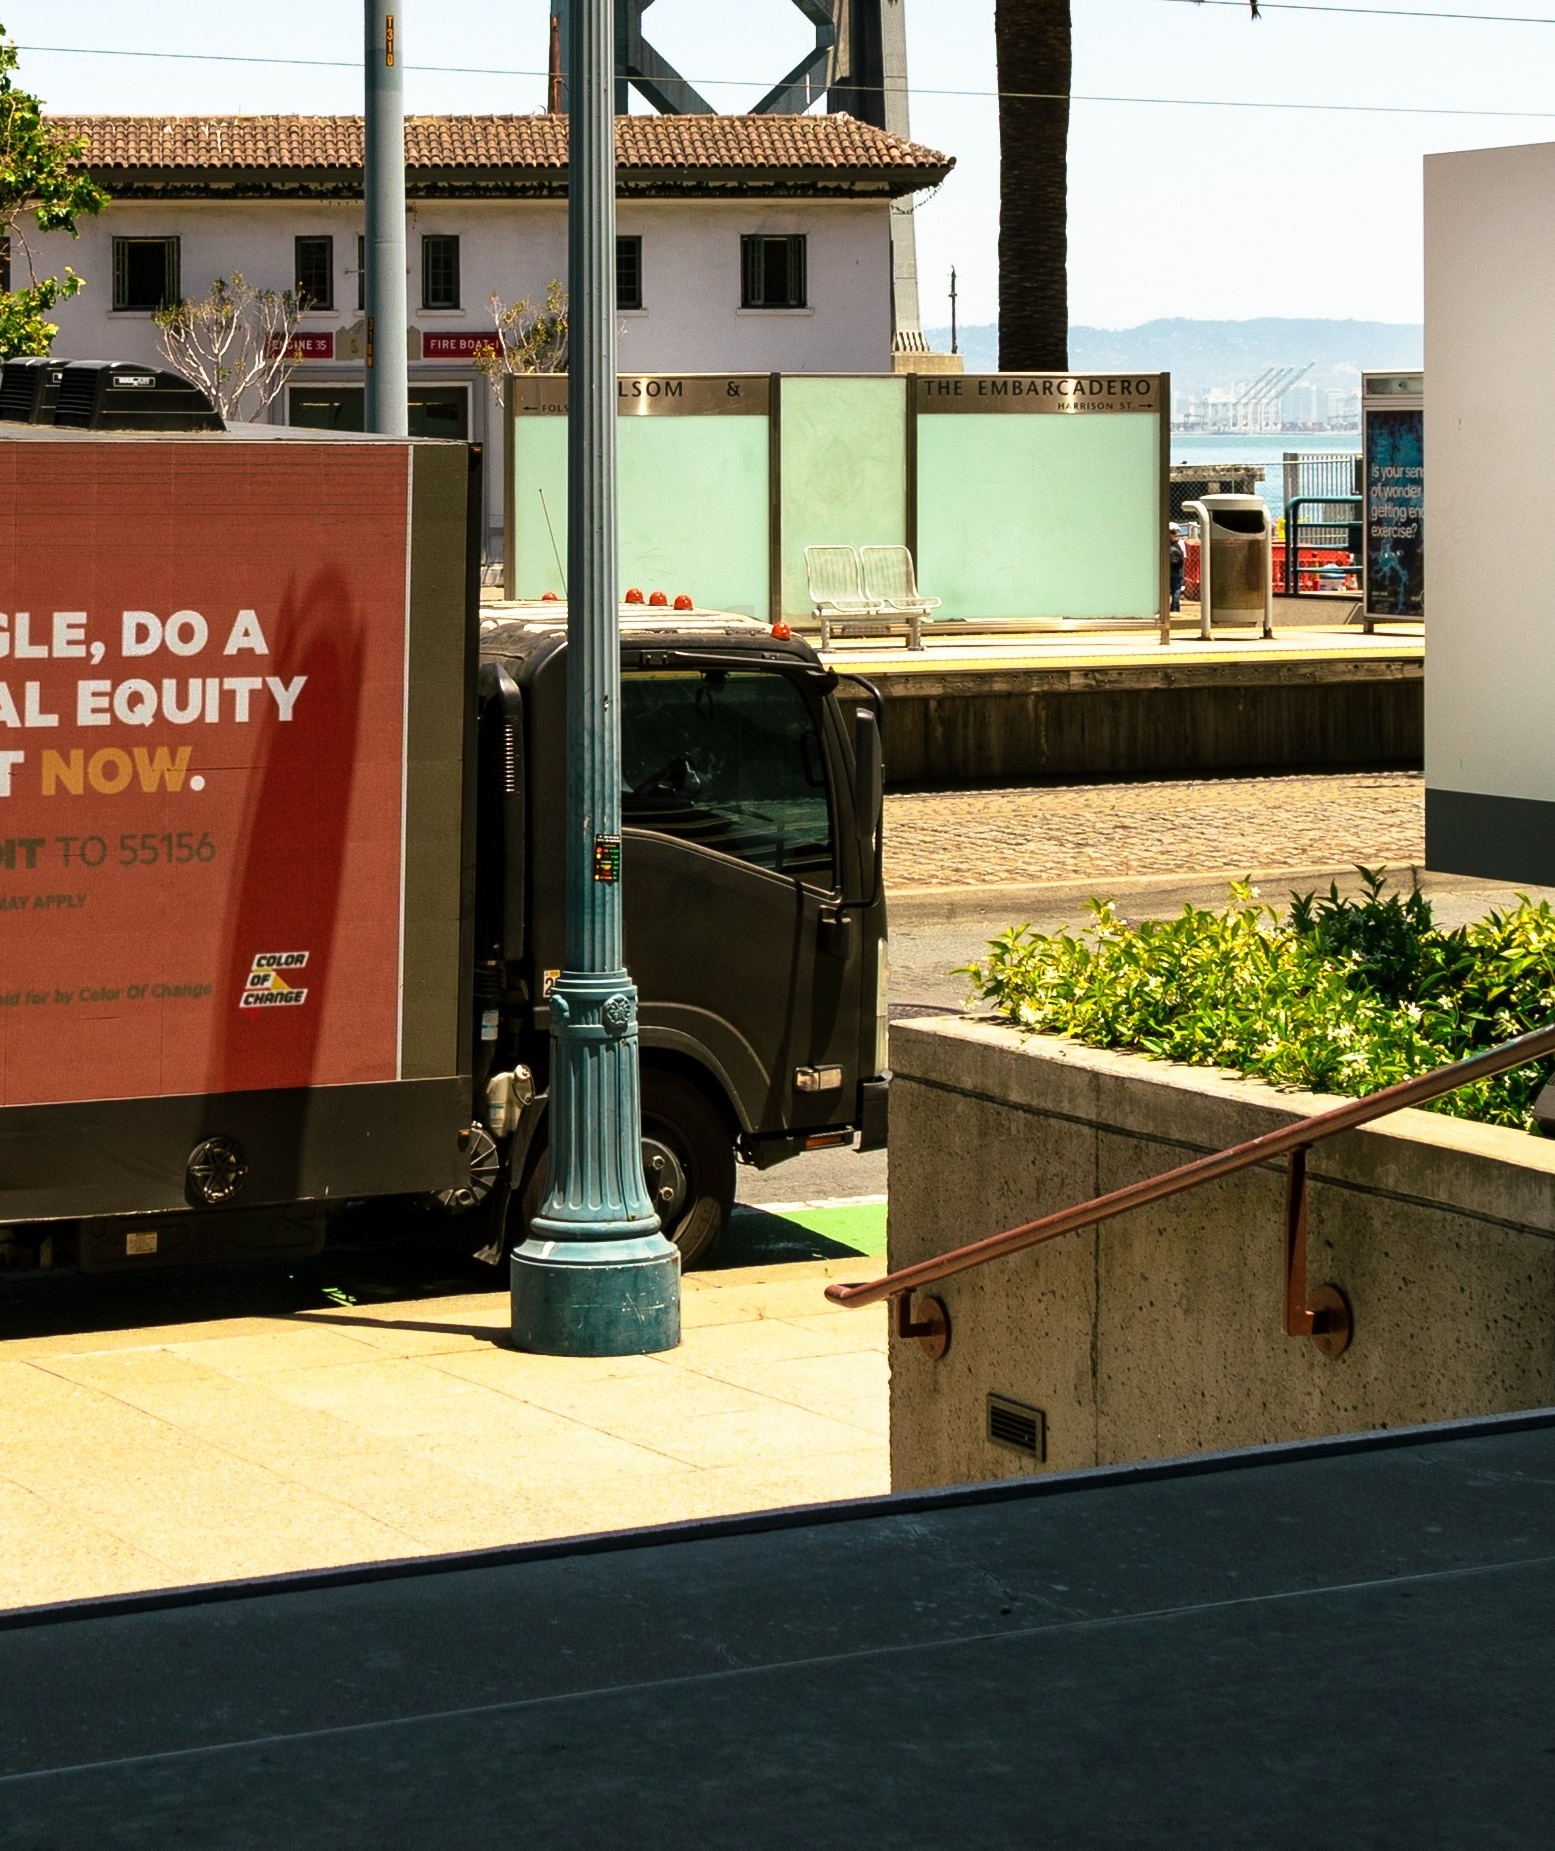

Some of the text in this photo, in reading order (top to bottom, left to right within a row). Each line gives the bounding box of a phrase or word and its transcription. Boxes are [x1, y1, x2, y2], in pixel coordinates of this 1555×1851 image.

[315, 340, 326, 350] 35
[430, 340, 456, 349] FIRE
[618, 379, 1151, 397] LSOM & THE EMBARCADERO
[542, 404, 568, 413] FOLS
[1057, 402, 1136, 410] HARRISON ST.
[1381, 466, 1404, 482] your
[1405, 466, 1424, 479] sen
[1371, 482, 1422, 498] of wonder
[1371, 503, 1407, 522] getting
[1371, 522, 1418, 539] exercise?
[122, 610, 209, 657] DO
[223, 609, 270, 656] A
[77, 676, 308, 727] EQUITY
[40, 745, 206, 797] NOW.
[55, 834, 107, 868] TO
[119, 832, 217, 866] 55156
[32, 893, 87, 910] APPLY
[256, 953, 306, 968] COLOR
[249, 974, 271, 987] OF
[25, 989, 48, 1005] for
[54, 988, 74, 1006] by
[78, 985, 121, 1003] Color
[126, 983, 148, 999] Of
[151, 982, 213, 1001] Change
[243, 990, 305, 1006] CHANGE
